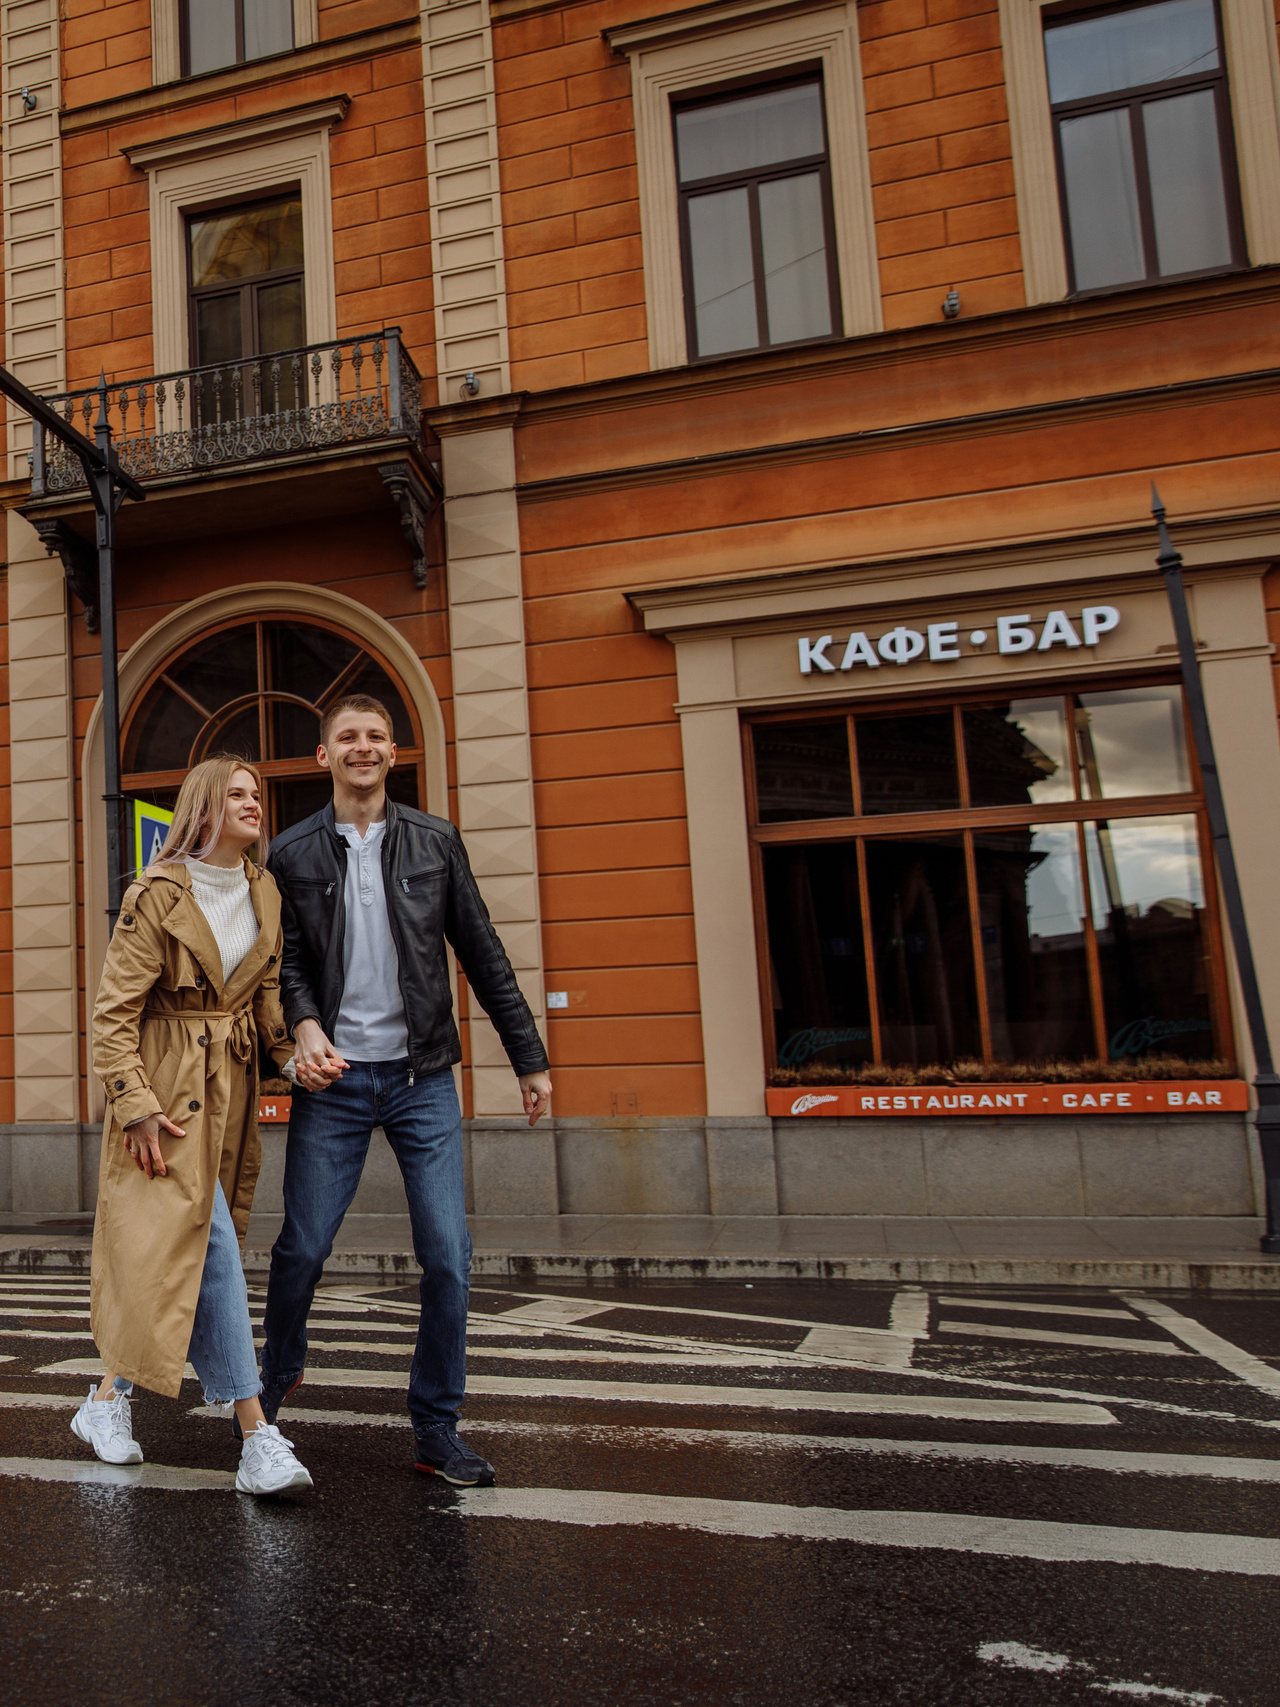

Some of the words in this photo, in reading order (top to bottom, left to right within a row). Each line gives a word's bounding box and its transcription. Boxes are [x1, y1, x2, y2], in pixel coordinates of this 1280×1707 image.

[798, 621, 961, 675] КАФЕ
[997, 606, 1120, 655] БАР
[861, 1093, 1028, 1110] RESTAURANT
[1062, 1092, 1133, 1108] CAFE
[1166, 1091, 1223, 1106] BAR
